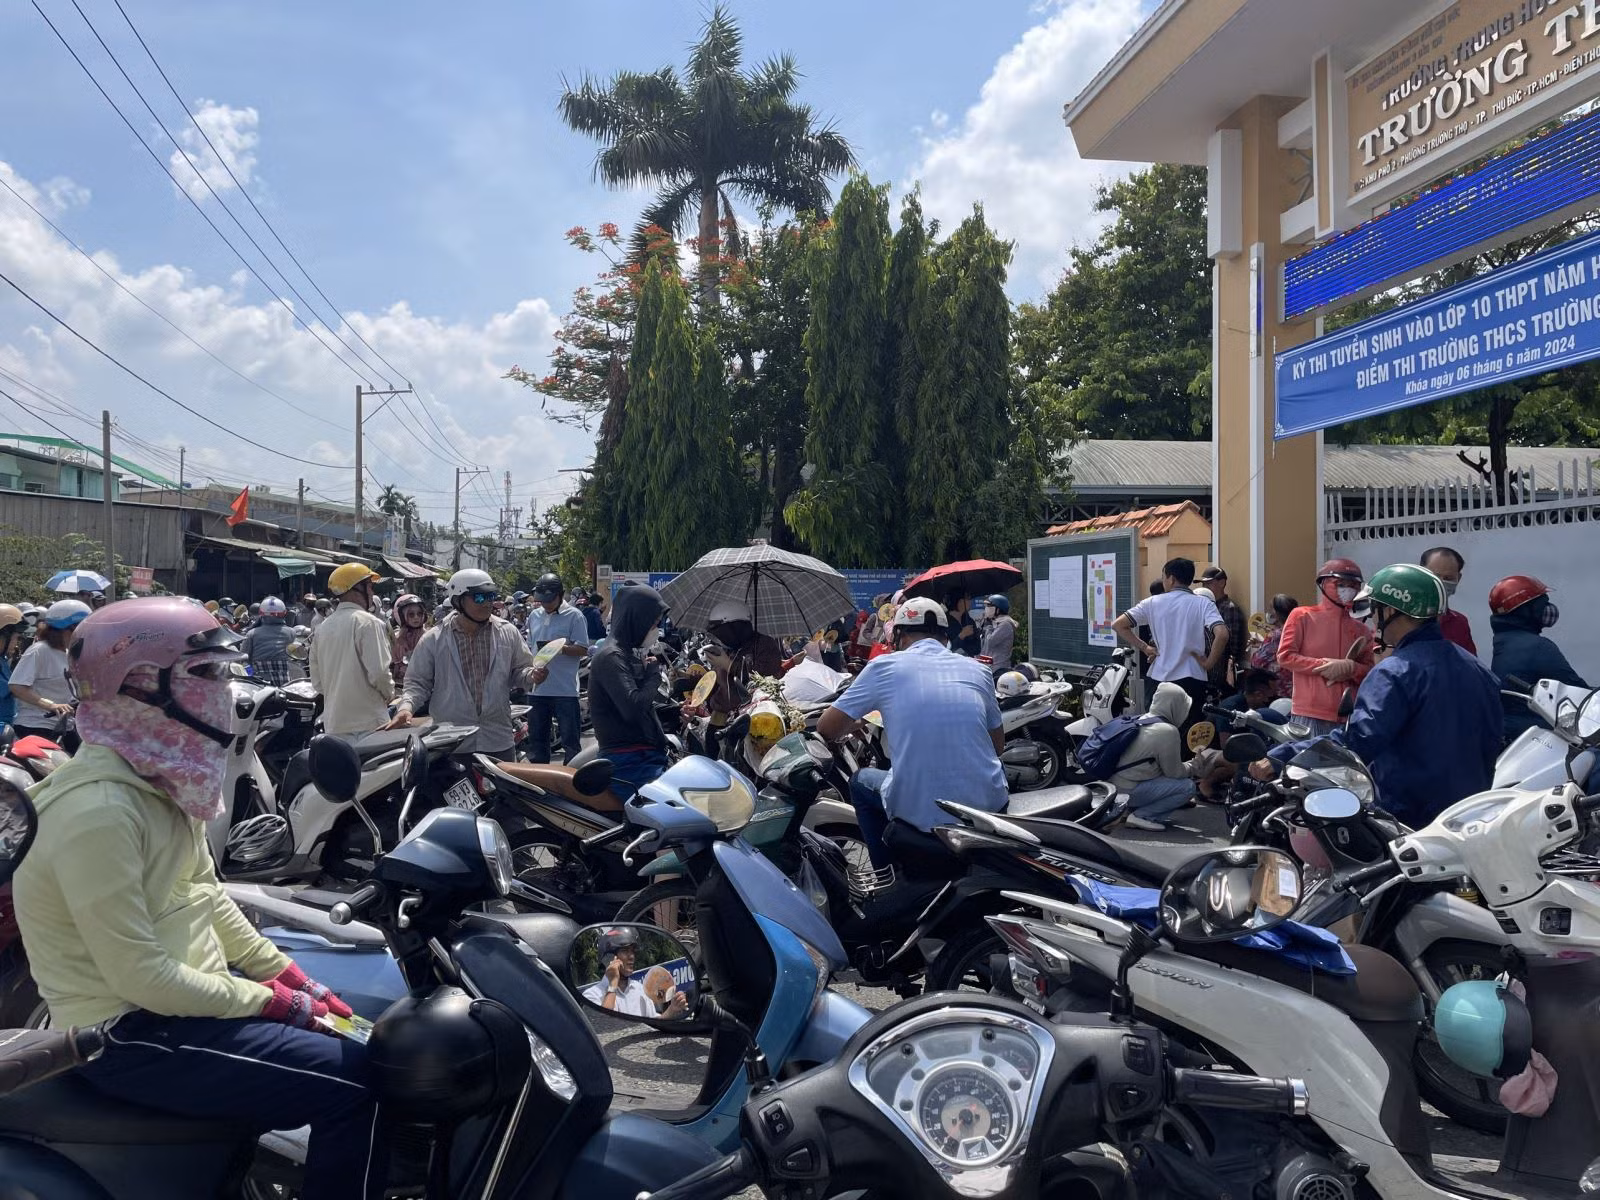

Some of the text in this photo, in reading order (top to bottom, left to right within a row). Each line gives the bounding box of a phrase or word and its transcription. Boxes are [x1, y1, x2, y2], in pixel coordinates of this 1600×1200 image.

[1453, 12, 1514, 66] TRUNG
[1358, 38, 1528, 166] TRƯỜNG
[1475, 110, 1488, 124] TP.
[1292, 356, 1307, 380] KỲ
[1309, 352, 1328, 376] THI
[1329, 334, 1368, 368] TUYỂN
[1371, 327, 1403, 355] SINH
[1405, 315, 1434, 343] VÀO
[1438, 303, 1466, 332] LỚP
[1472, 295, 1492, 320] 10
[1495, 277, 1539, 312] THPT
[1543, 261, 1586, 296] NĂM
[1356, 295, 1600, 390] ĐIỂM THI TRƯỜNG THCS TRƯỜNG
[1405, 334, 1576, 395] Khóa ngày 06 tháng 6 năm 2024
[1381, 583, 1412, 602] Grab
